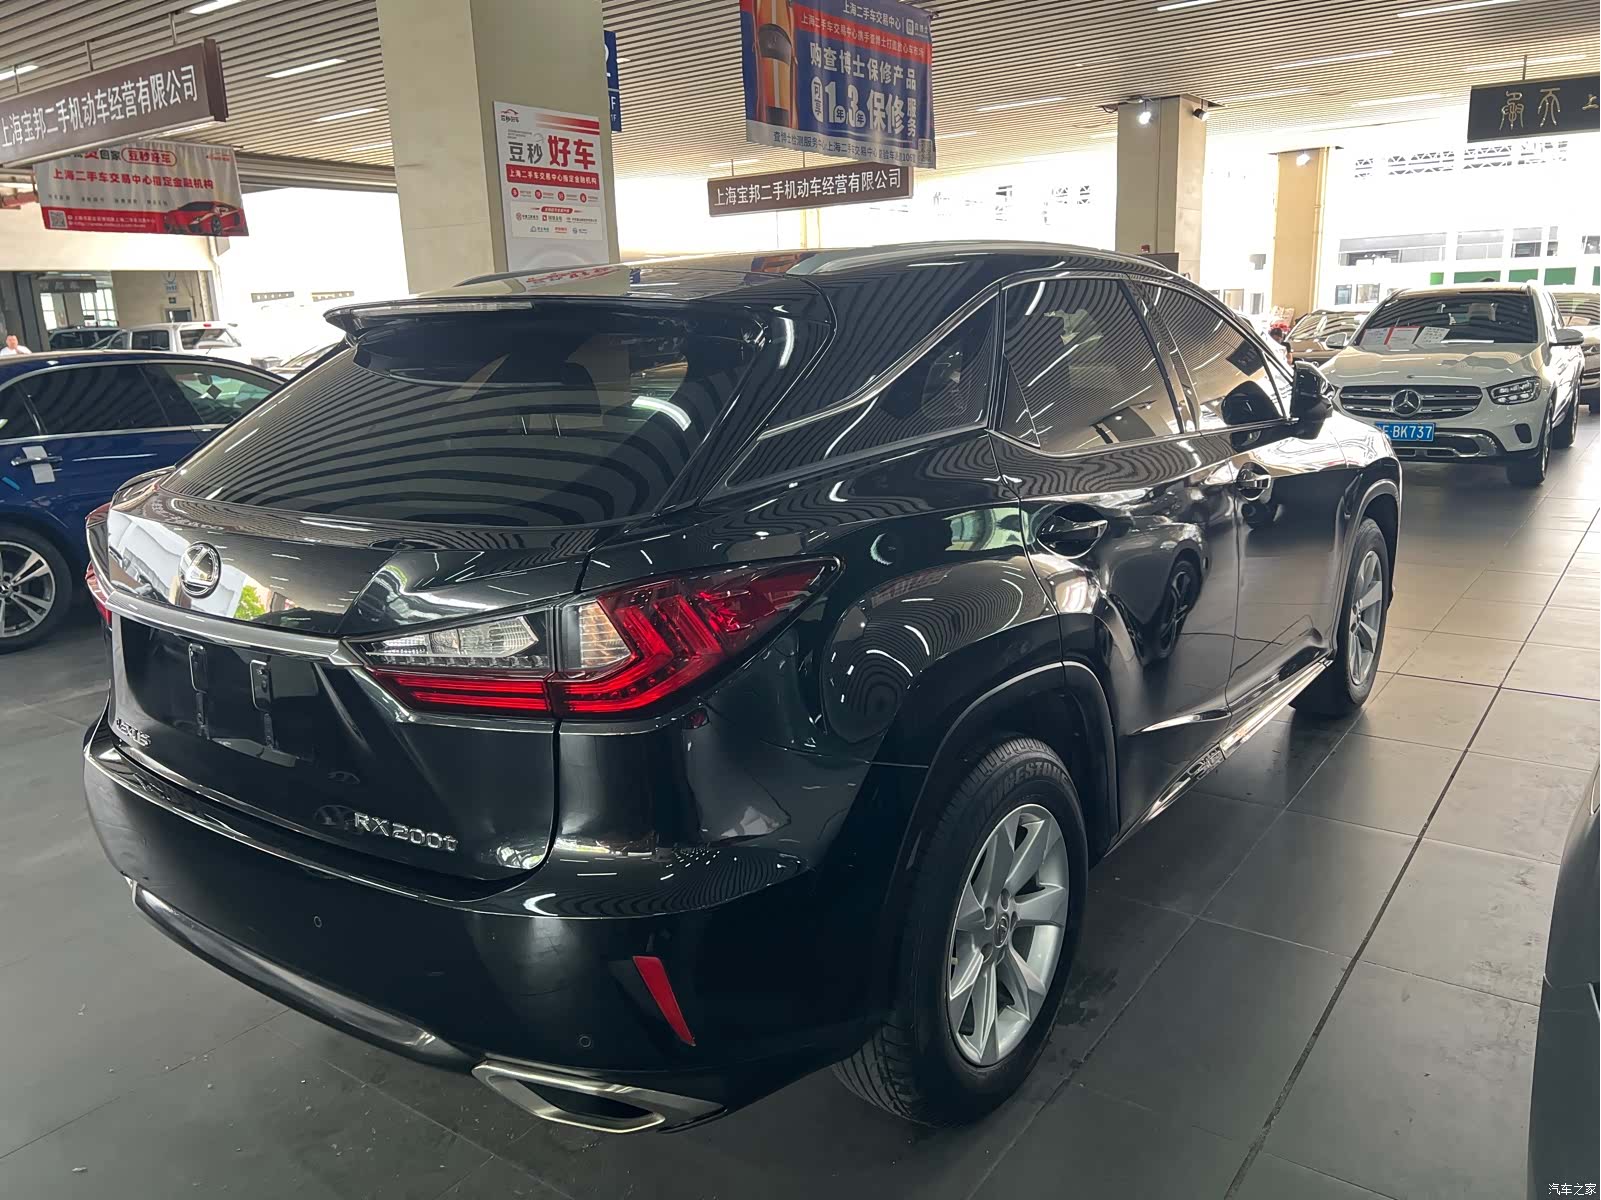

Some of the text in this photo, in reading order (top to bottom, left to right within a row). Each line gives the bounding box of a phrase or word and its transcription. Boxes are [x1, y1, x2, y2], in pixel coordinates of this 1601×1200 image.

[842, 0, 901, 30] 上海二手车交易中心
[809, 42, 917, 90] 购查博士保修产品
[1, 64, 198, 148] 上海宝邦二手机动车经营有限公司
[128, 150, 172, 165] 豆秒好车
[53, 168, 214, 190] 上海二手车交易中心指定金融机构
[509, 169, 597, 185] 上海二手车交易中心指定金融机构
[714, 168, 901, 206] 上海宝邦二手机动车经营有限公司
